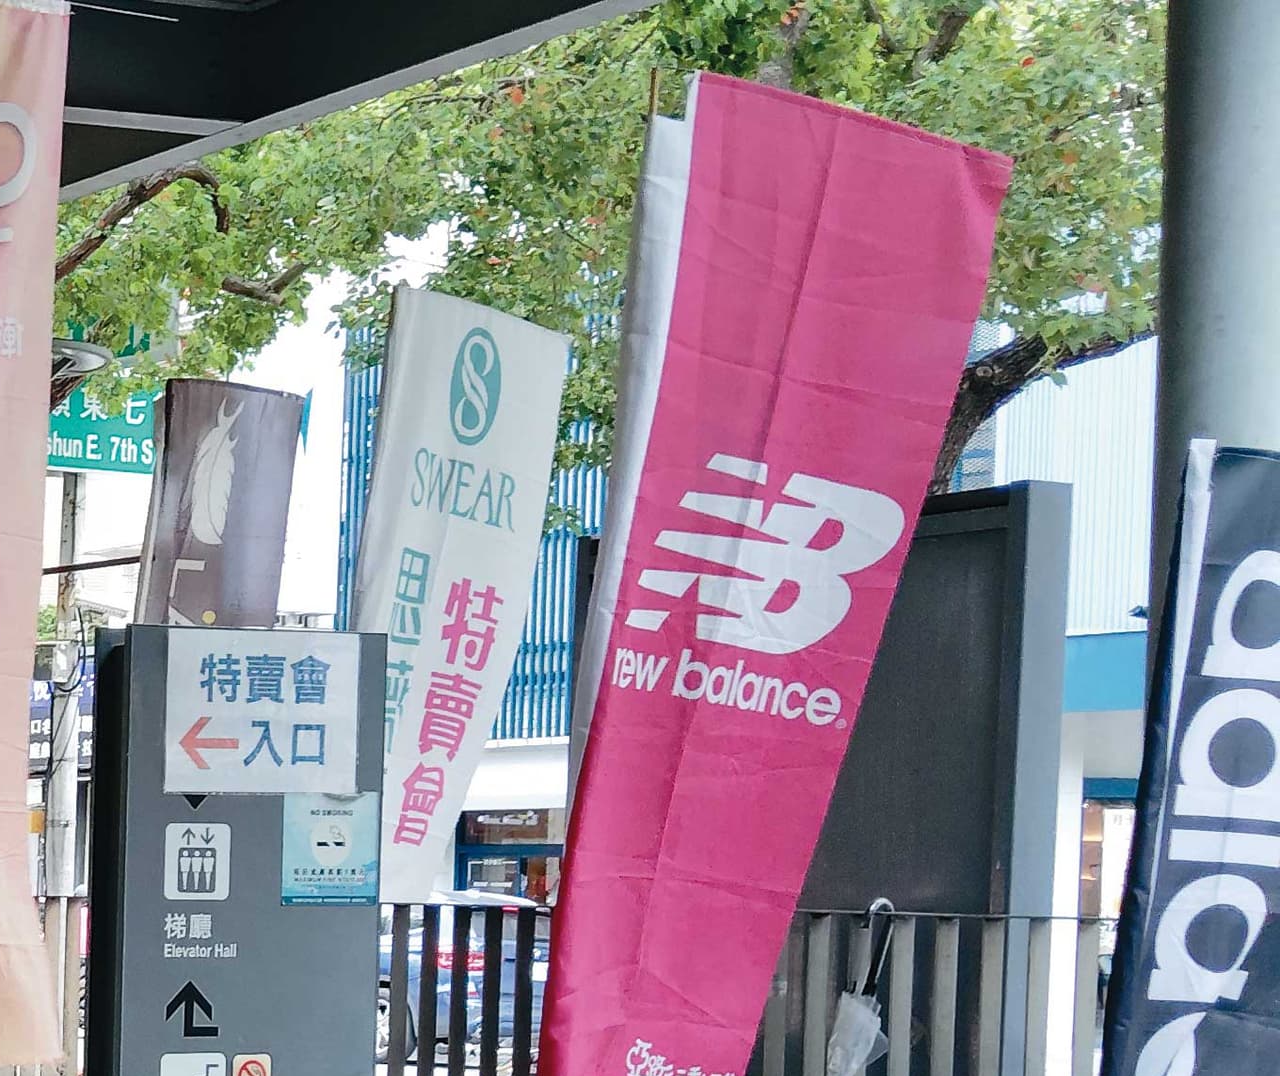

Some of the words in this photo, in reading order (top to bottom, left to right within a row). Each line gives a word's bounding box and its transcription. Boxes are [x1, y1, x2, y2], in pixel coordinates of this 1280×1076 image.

[109, 436, 138, 463] 7th
[411, 447, 516, 532] SWEAR
[200, 653, 331, 705] 特賣會
[672, 648, 842, 727] balance
[393, 577, 505, 847] 特賣會
[243, 720, 326, 767] 入口
[164, 943, 212, 959] Elevator
[214, 943, 238, 959] Hall
